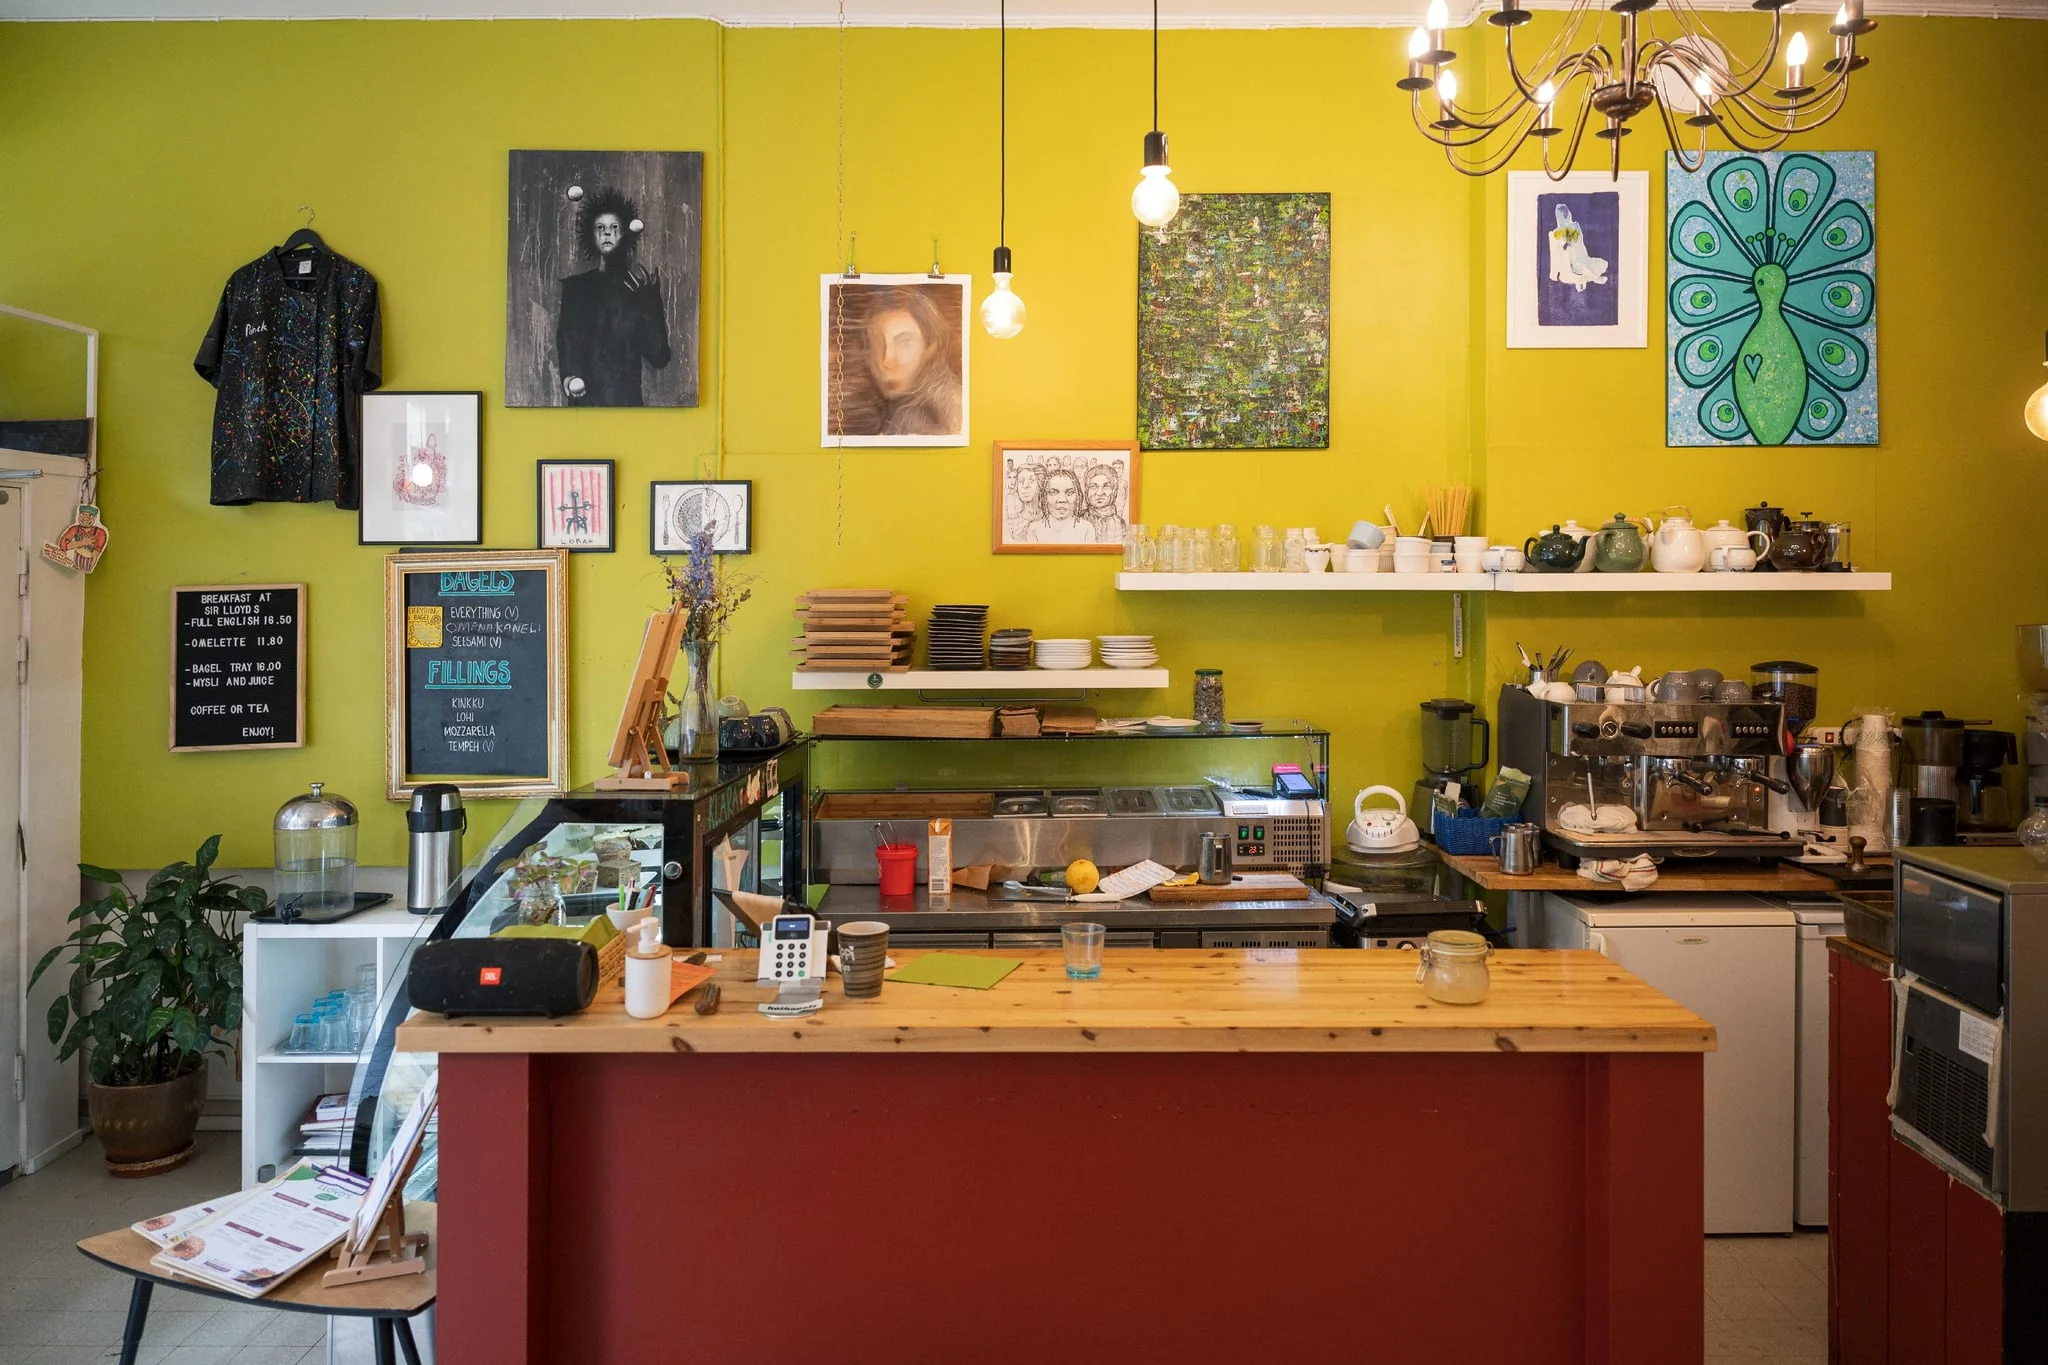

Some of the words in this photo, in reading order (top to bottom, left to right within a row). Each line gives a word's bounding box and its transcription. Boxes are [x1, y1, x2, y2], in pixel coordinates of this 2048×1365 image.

[201, 593, 252, 604] BREAKFAST
[259, 592, 272, 602] AT
[204, 605, 219, 615] SIR
[450, 605, 501, 619] EVERYTHING
[504, 605, 519, 620] (V)
[217, 616, 260, 627] ENGLISH
[257, 636, 283, 646] 11.80
[230, 662, 252, 672] TRAY
[256, 661, 281, 672] 16.00
[428, 660, 511, 684] FILLINGS
[226, 676, 246, 686] AND
[248, 675, 275, 686] JUICE
[190, 705, 226, 715] COFFEE
[230, 704, 243, 714] OR
[247, 703, 269, 713] TEA
[451, 697, 485, 709] KINKKU
[456, 711, 474, 722] LOHI
[242, 726, 274, 739] ENJOY!
[444, 725, 496, 737] MOZZARELLA
[448, 740, 480, 752] TEMPEH
